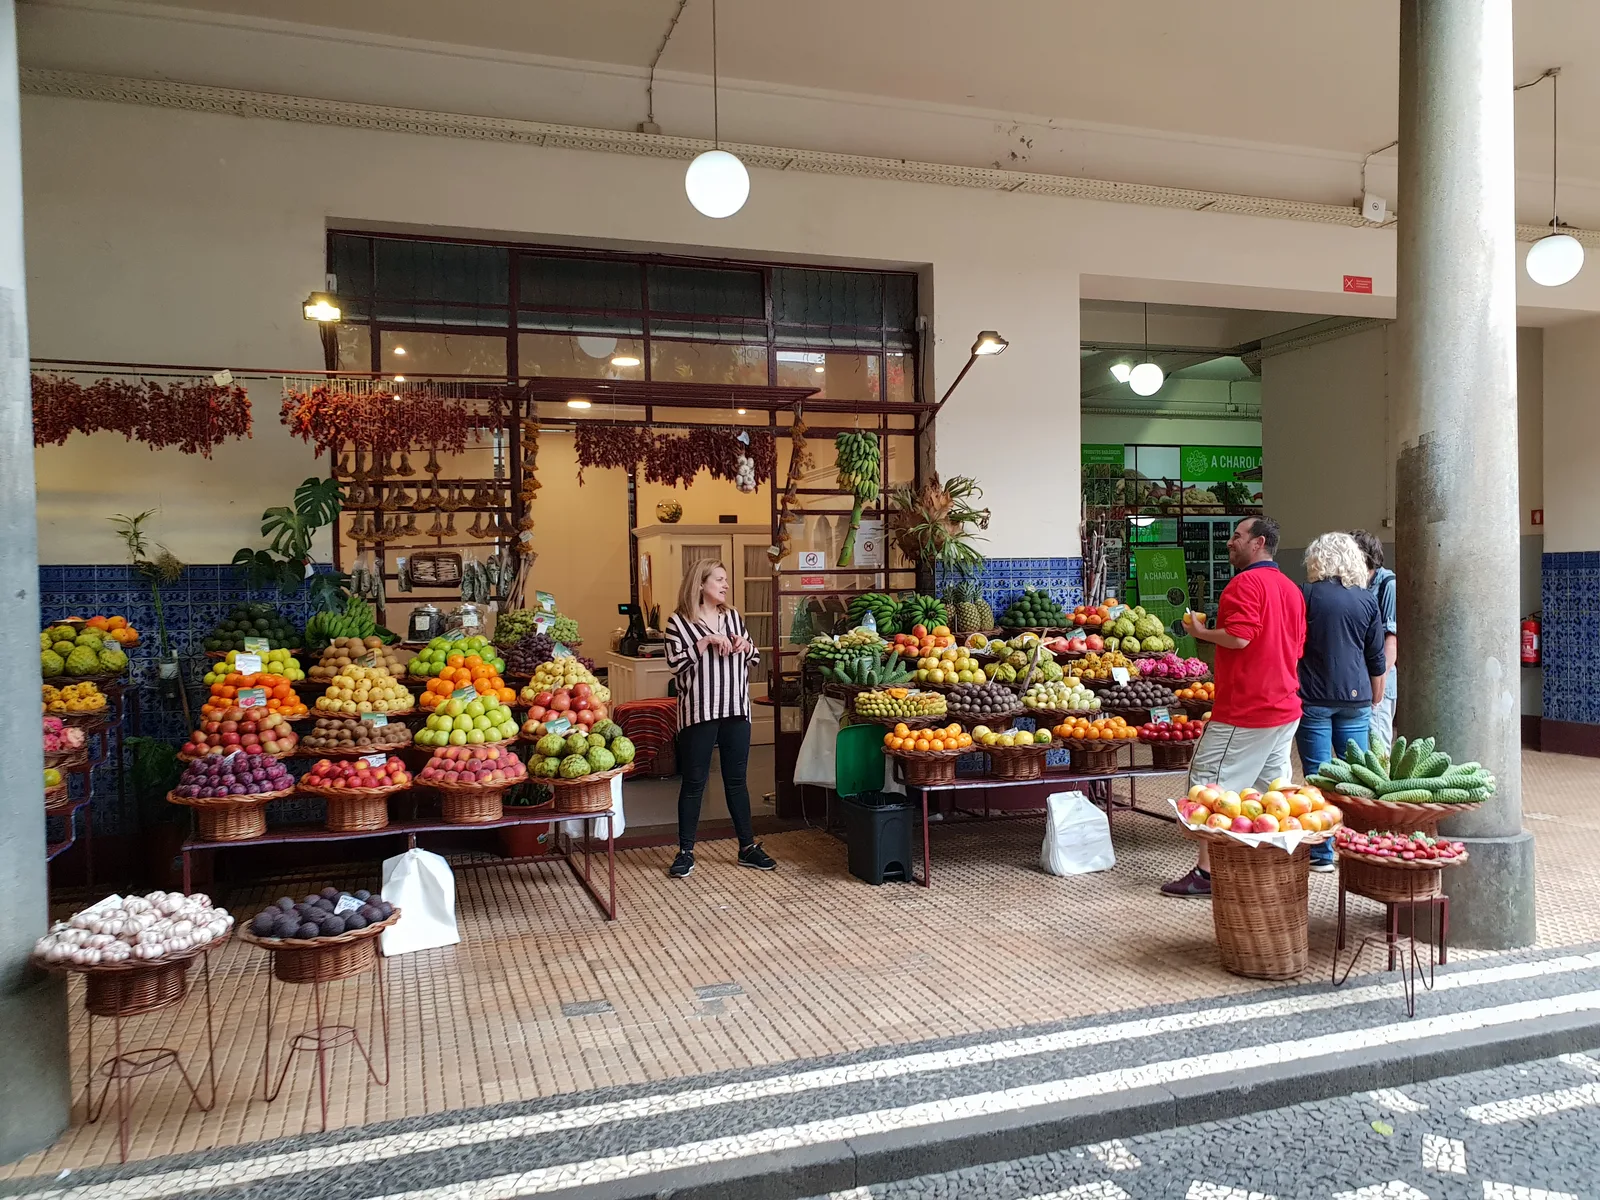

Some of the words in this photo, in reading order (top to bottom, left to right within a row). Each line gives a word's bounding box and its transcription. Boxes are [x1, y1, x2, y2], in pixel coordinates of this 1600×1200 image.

[1211, 455, 1218, 468] A
[1144, 572, 1149, 580] A
[1149, 571, 1179, 580] CHAROLA
